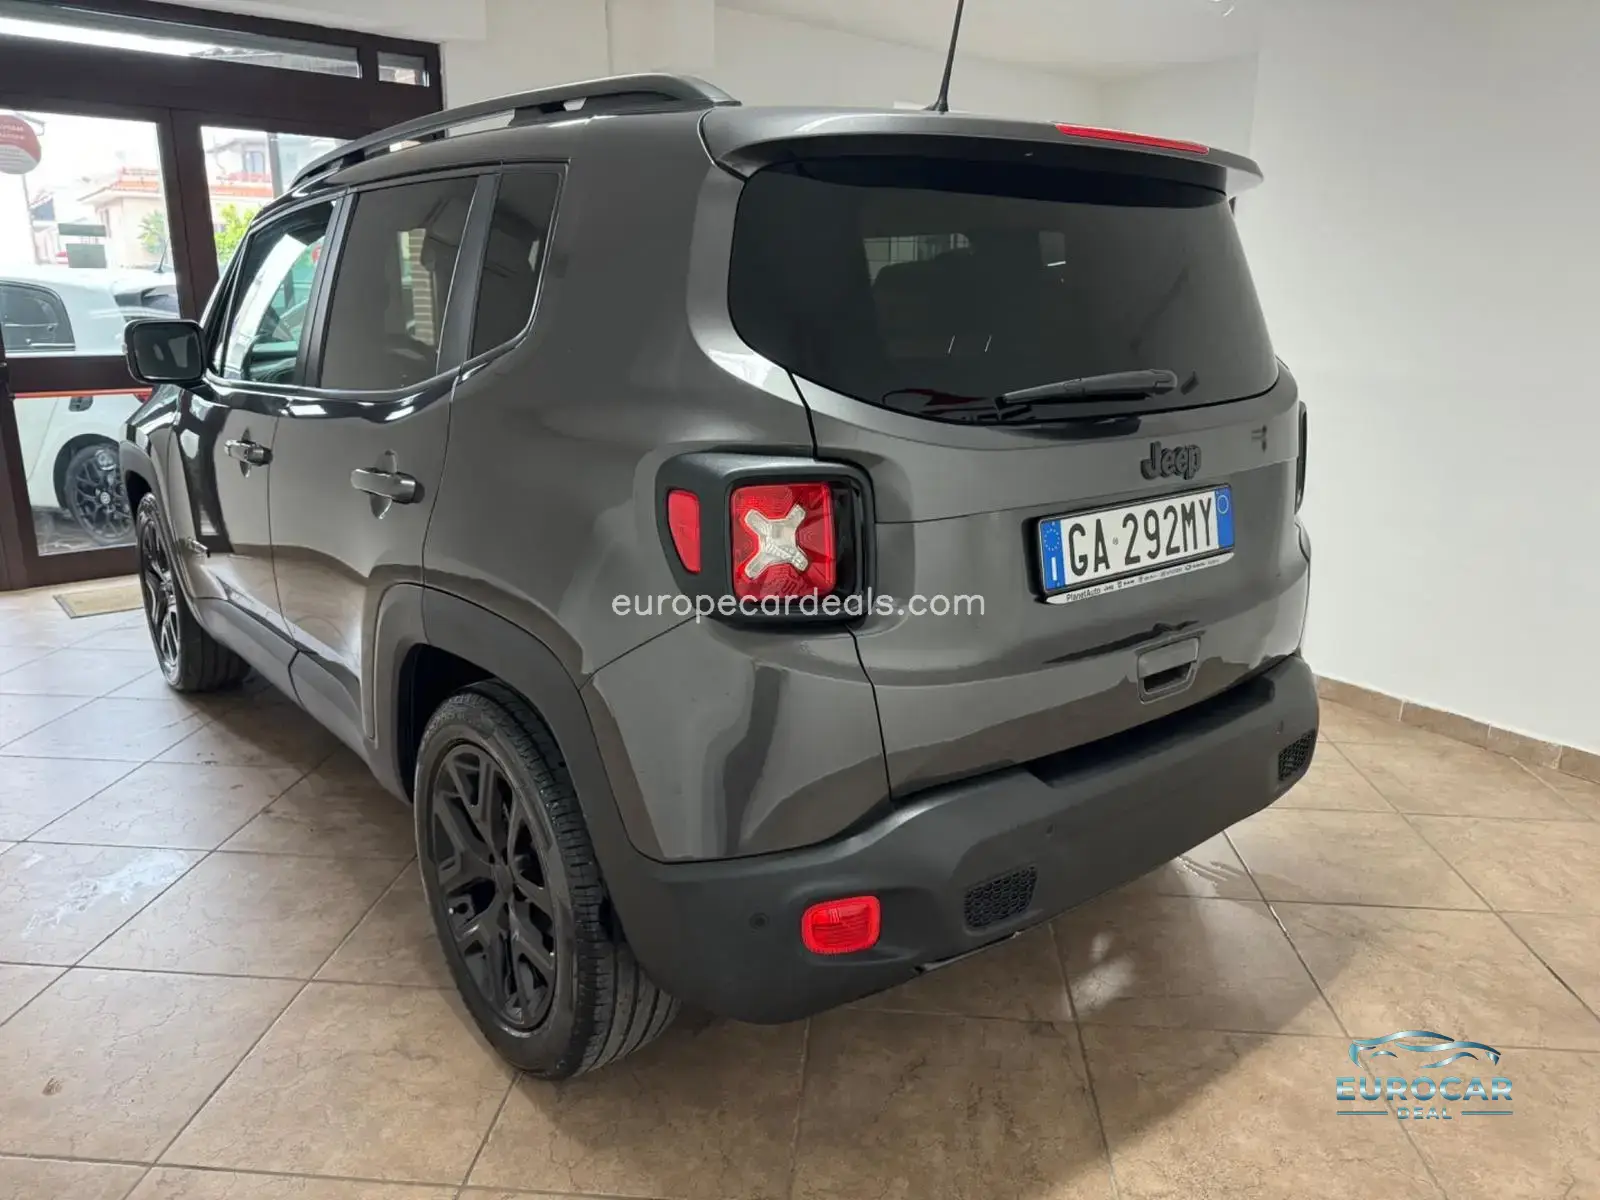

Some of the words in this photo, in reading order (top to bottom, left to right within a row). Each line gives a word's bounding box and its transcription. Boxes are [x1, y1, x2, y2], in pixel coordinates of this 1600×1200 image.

[1140, 441, 1202, 480] Jeep
[1068, 518, 1111, 577] GA
[1122, 497, 1213, 566] 292MY
